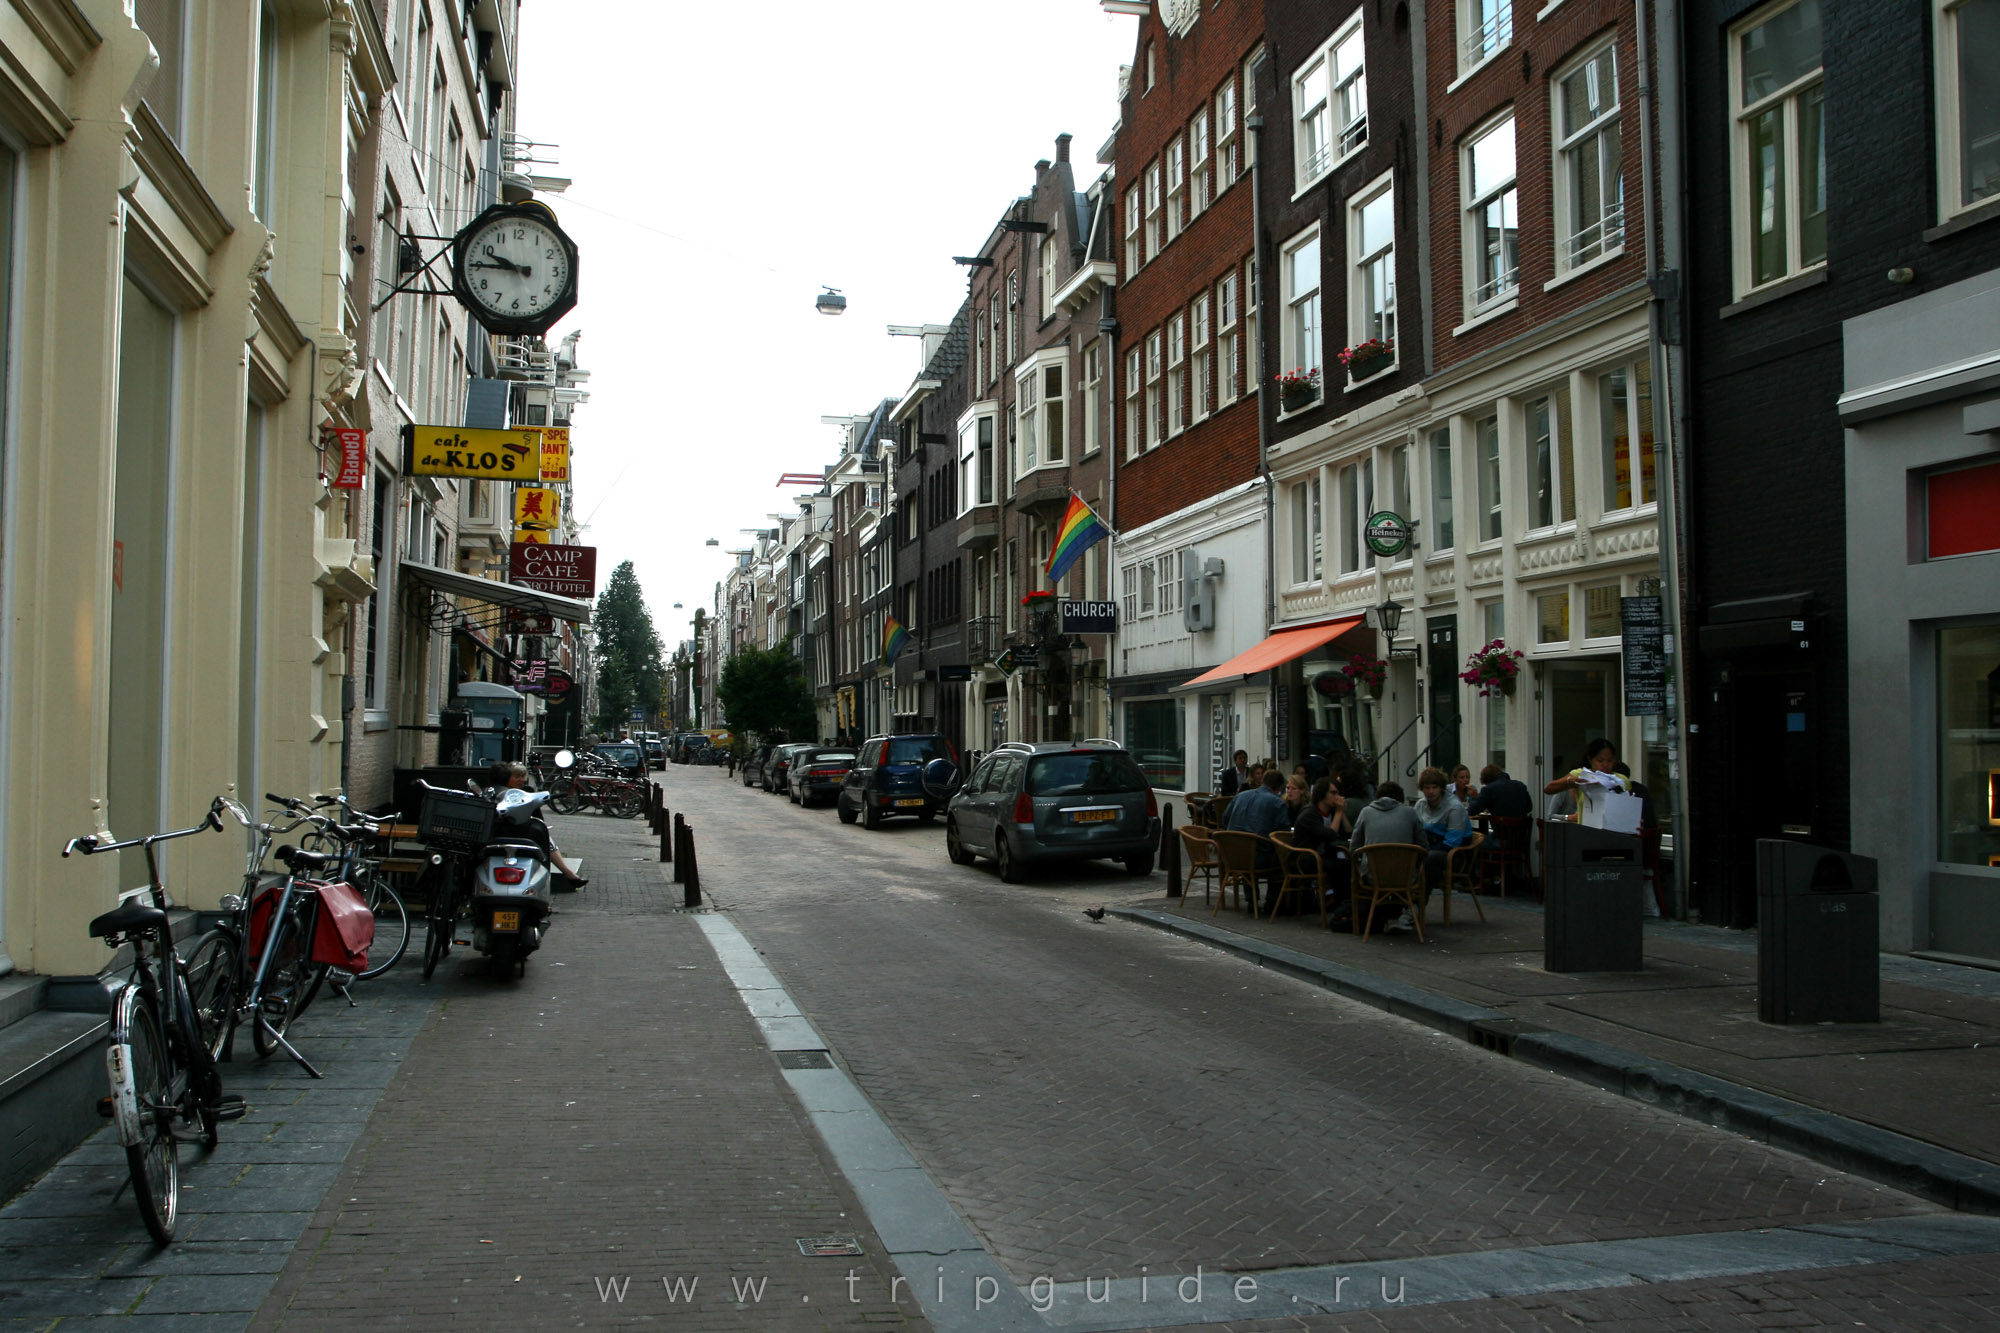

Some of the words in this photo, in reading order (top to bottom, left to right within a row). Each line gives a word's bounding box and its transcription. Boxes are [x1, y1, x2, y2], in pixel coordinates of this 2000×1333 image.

[497, 233, 505, 244] 11
[513, 228, 525, 240] 12
[535, 234, 539, 246] 1
[482, 245, 494, 256] 10
[546, 249, 554, 260] 2
[475, 260, 484, 271] 9
[552, 266, 559, 277] 3
[480, 279, 488, 290] 8
[544, 284, 551, 295] 4
[494, 292, 502, 303] 7
[530, 295, 537, 306] 5
[511, 298, 519, 309] 6
[340, 432, 360, 484] CAMPER
[421, 455, 440, 465] de
[446, 450, 515, 471] KLOS
[521, 491, 543, 520] 美
[524, 546, 582, 562] CAMP
[525, 562, 579, 578] CAFÉ
[550, 581, 590, 593] HOTEL
[1064, 601, 1114, 617] CHURCH
[1212, 704, 1223, 796] CHURCH
